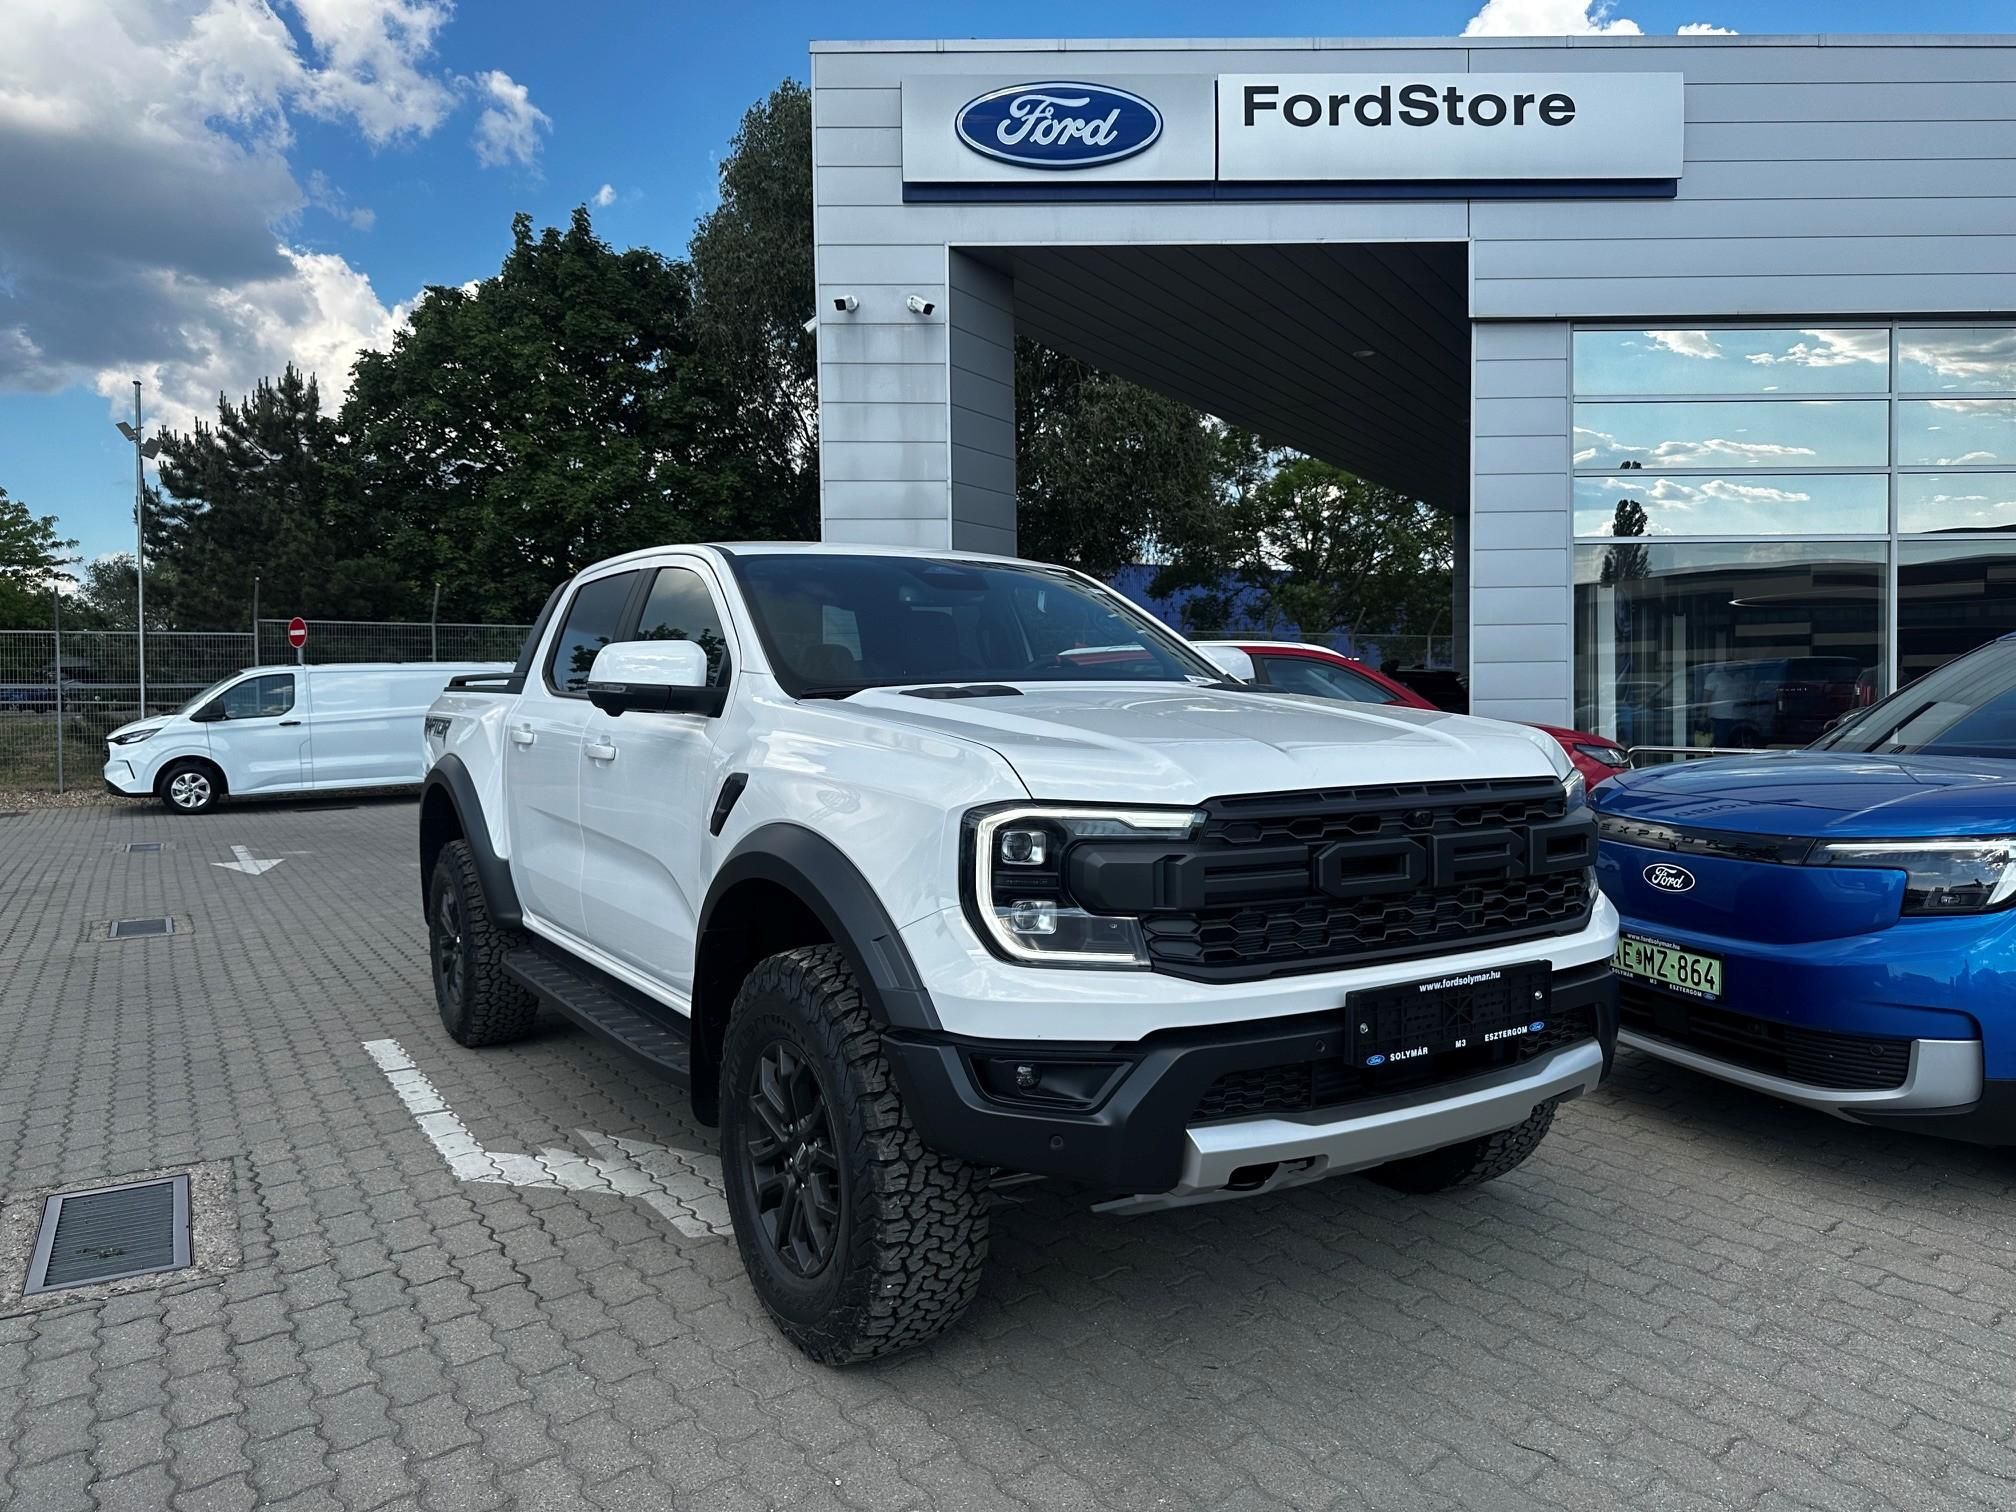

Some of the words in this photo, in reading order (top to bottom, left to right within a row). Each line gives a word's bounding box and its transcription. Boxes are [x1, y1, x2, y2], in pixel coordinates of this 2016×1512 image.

[996, 93, 1121, 147] Ford
[1242, 83, 1577, 127] FordStore
[1174, 808, 1598, 910] FORD
[1652, 866, 1684, 888] Ford
[1419, 970, 1501, 993] www.fordsolymar.hu
[1389, 1046, 1428, 1062] SOLYMÁR
[1455, 1039, 1467, 1049] M3
[1484, 1025, 1528, 1042] ESZTERGOM
